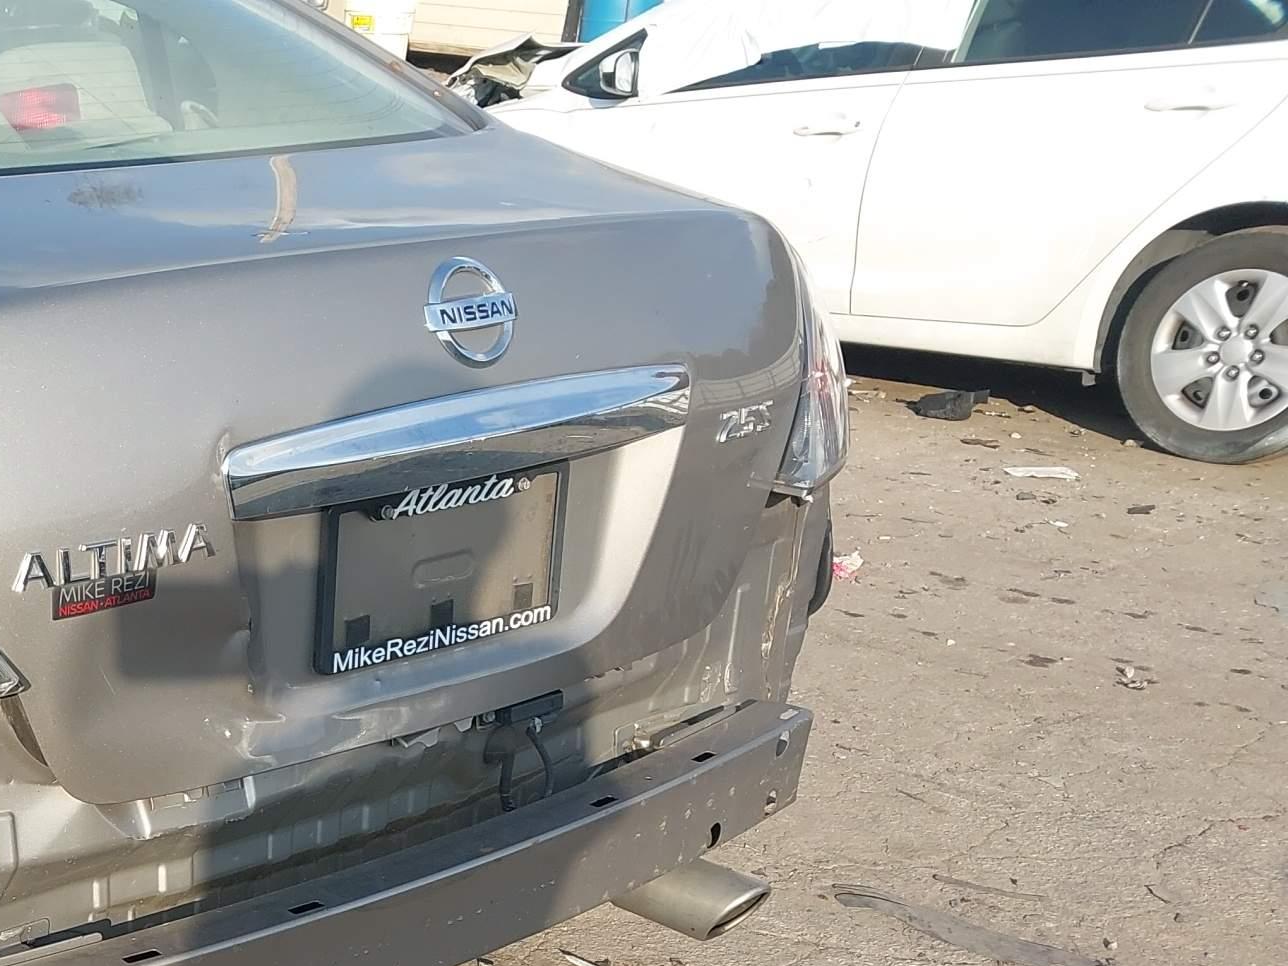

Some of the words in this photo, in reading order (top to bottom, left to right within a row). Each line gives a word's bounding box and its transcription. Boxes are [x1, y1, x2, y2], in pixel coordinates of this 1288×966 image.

[440, 299, 514, 325] NISSAN
[392, 474, 515, 520] Atlanta
[11, 521, 216, 593] ALTIMA
[58, 580, 105, 608] MIKE
[111, 570, 150, 595] REZI
[332, 604, 552, 674] MikeReziNissan.com
